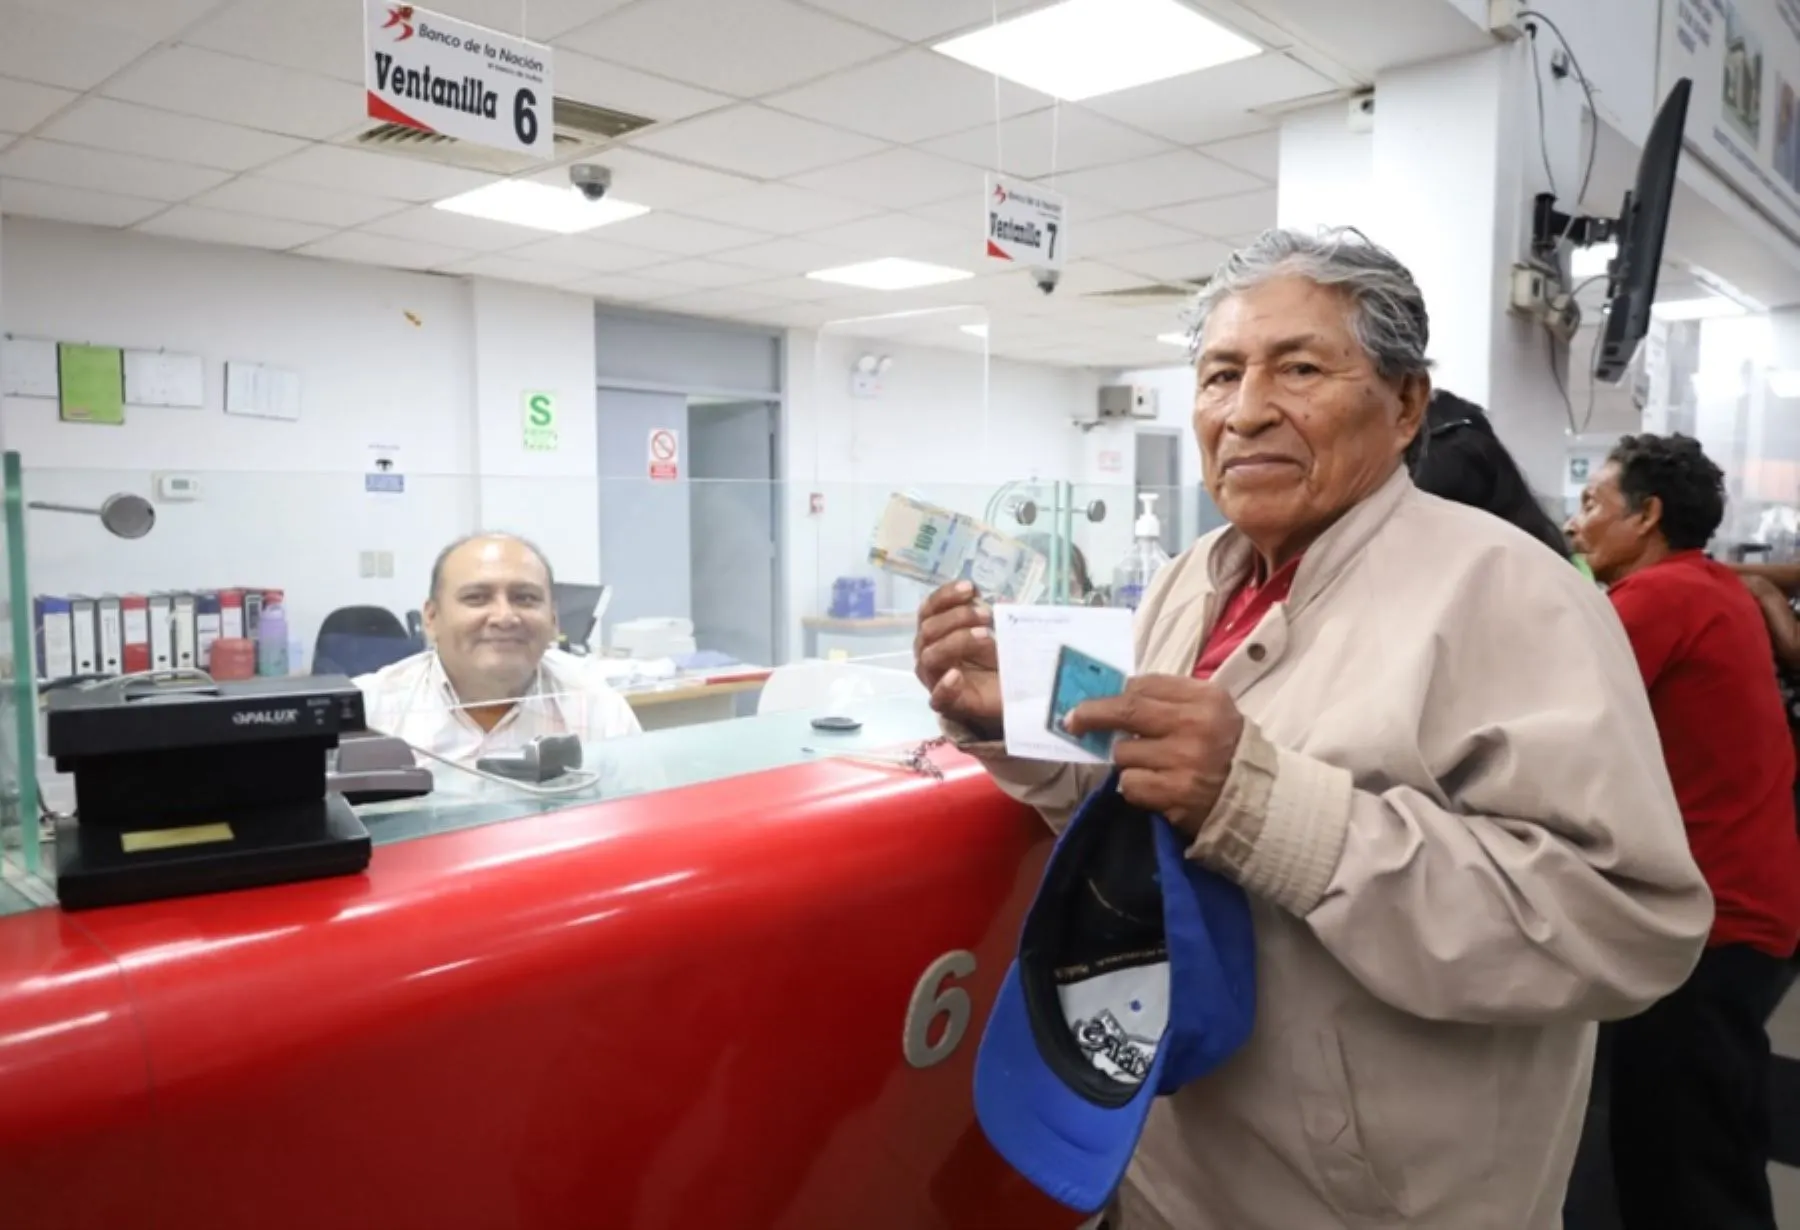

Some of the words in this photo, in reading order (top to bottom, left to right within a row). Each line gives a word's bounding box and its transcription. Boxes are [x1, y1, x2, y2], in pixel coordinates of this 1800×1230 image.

[418, 23, 460, 48] Banco
[464, 38, 481, 53] de
[484, 43, 496, 58] la
[499, 48, 543, 72] Nación
[375, 52, 498, 119] Ventanilla
[513, 87, 538, 145] 6
[1047, 222, 1057, 260] 7
[530, 395, 551, 426] S
[903, 948, 976, 1068] 6
